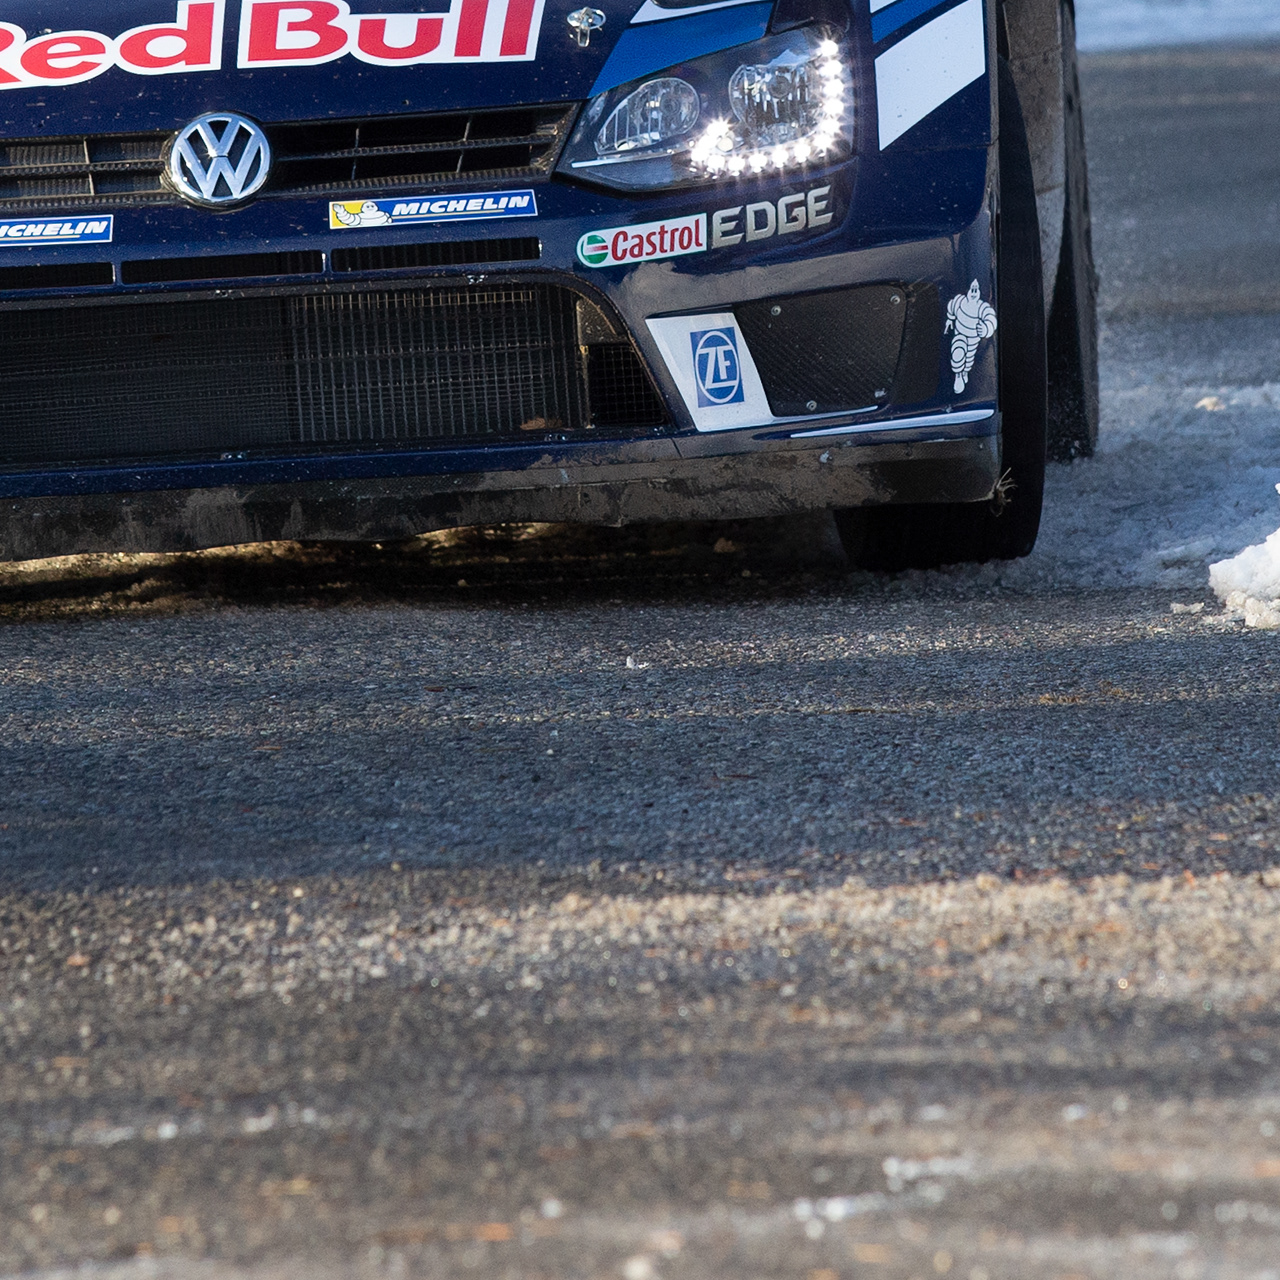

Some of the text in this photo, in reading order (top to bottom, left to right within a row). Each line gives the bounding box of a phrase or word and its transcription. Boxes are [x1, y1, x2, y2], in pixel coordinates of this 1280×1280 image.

[391, 194, 533, 217] MICHELIN
[610, 184, 835, 261] Castrol EDGE
[697, 345, 738, 390] ZF
